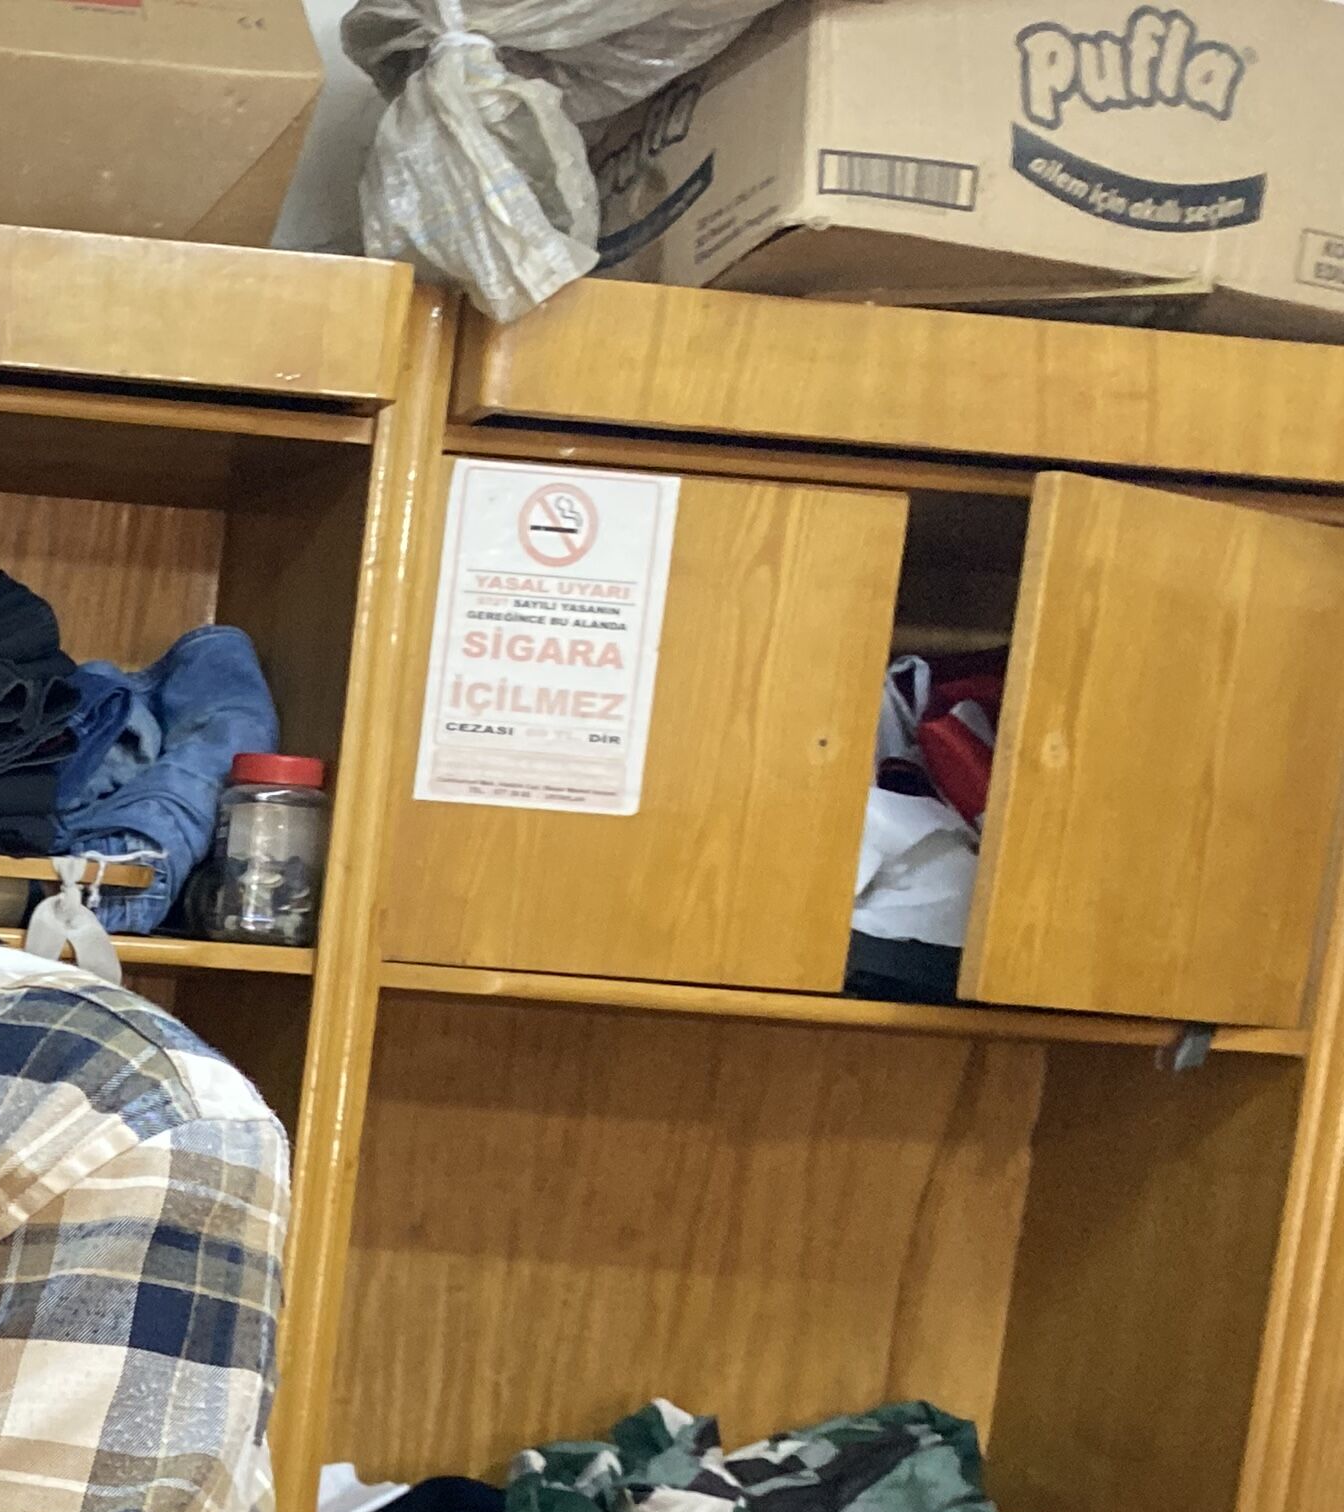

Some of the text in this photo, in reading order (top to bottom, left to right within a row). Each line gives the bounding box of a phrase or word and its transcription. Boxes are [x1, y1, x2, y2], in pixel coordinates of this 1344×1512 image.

[1016, 5, 1246, 129] pufla
[475, 575, 630, 600] YASAL UYARI
[466, 608, 626, 632] GEREĞİNCE BU ALANDA
[463, 627, 623, 669] SİGARA
[450, 674, 626, 720] İÇİLMEZ
[445, 721, 514, 736] CEZASI
[588, 731, 621, 745] DİR
